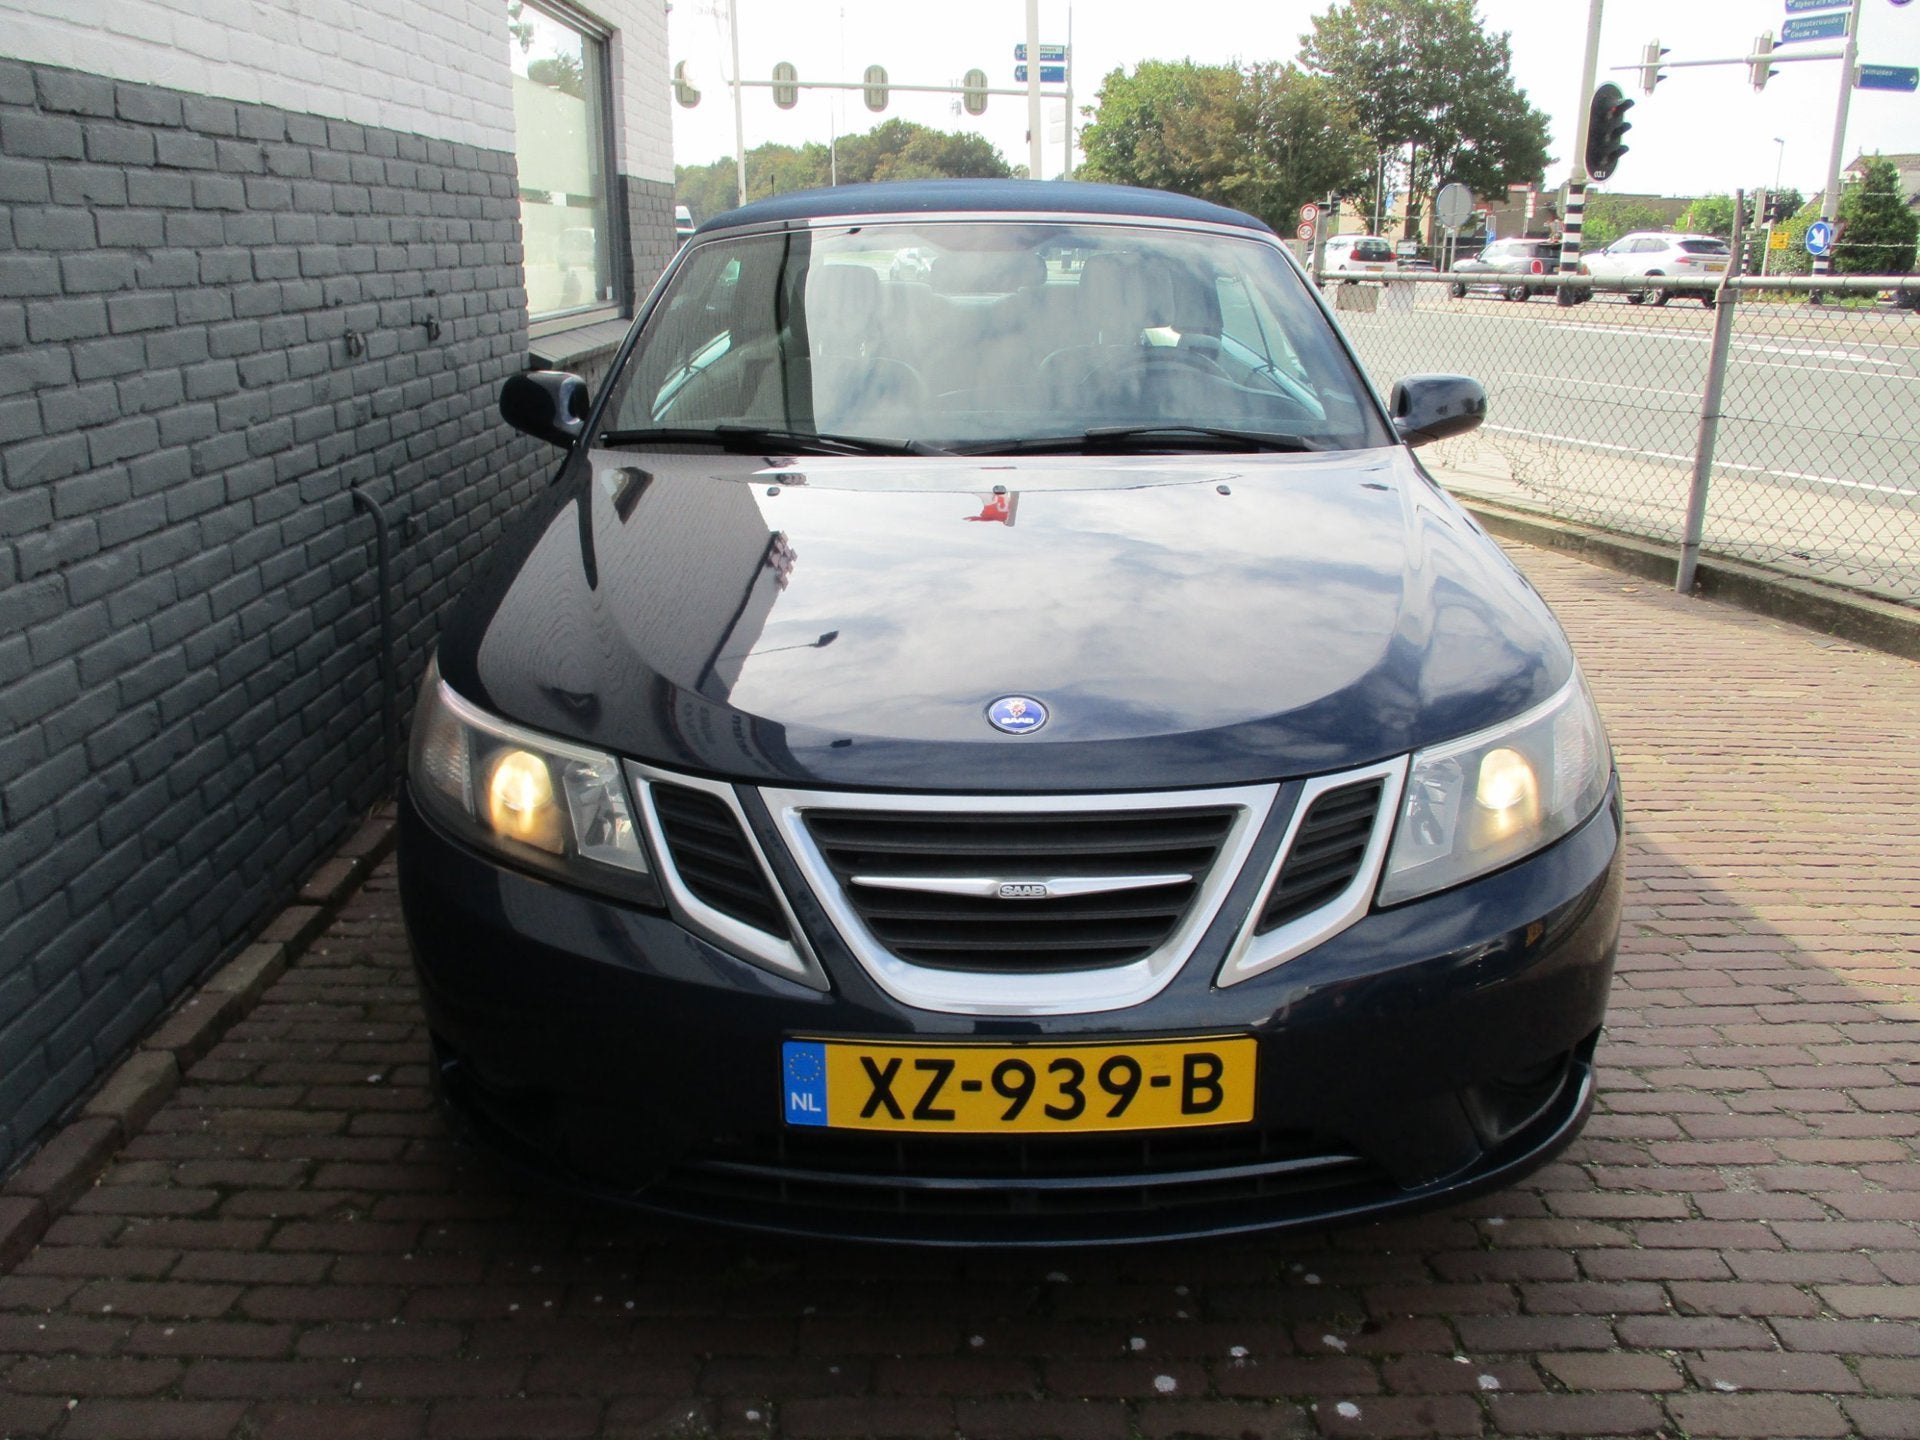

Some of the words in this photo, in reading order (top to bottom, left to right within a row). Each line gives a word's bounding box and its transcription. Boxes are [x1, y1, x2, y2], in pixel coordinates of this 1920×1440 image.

[1301, 227, 1311, 236] 50
[1001, 885, 1045, 896] SAAB
[859, 1052, 1224, 1121] XZ-939-B
[791, 1092, 821, 1113] NL
